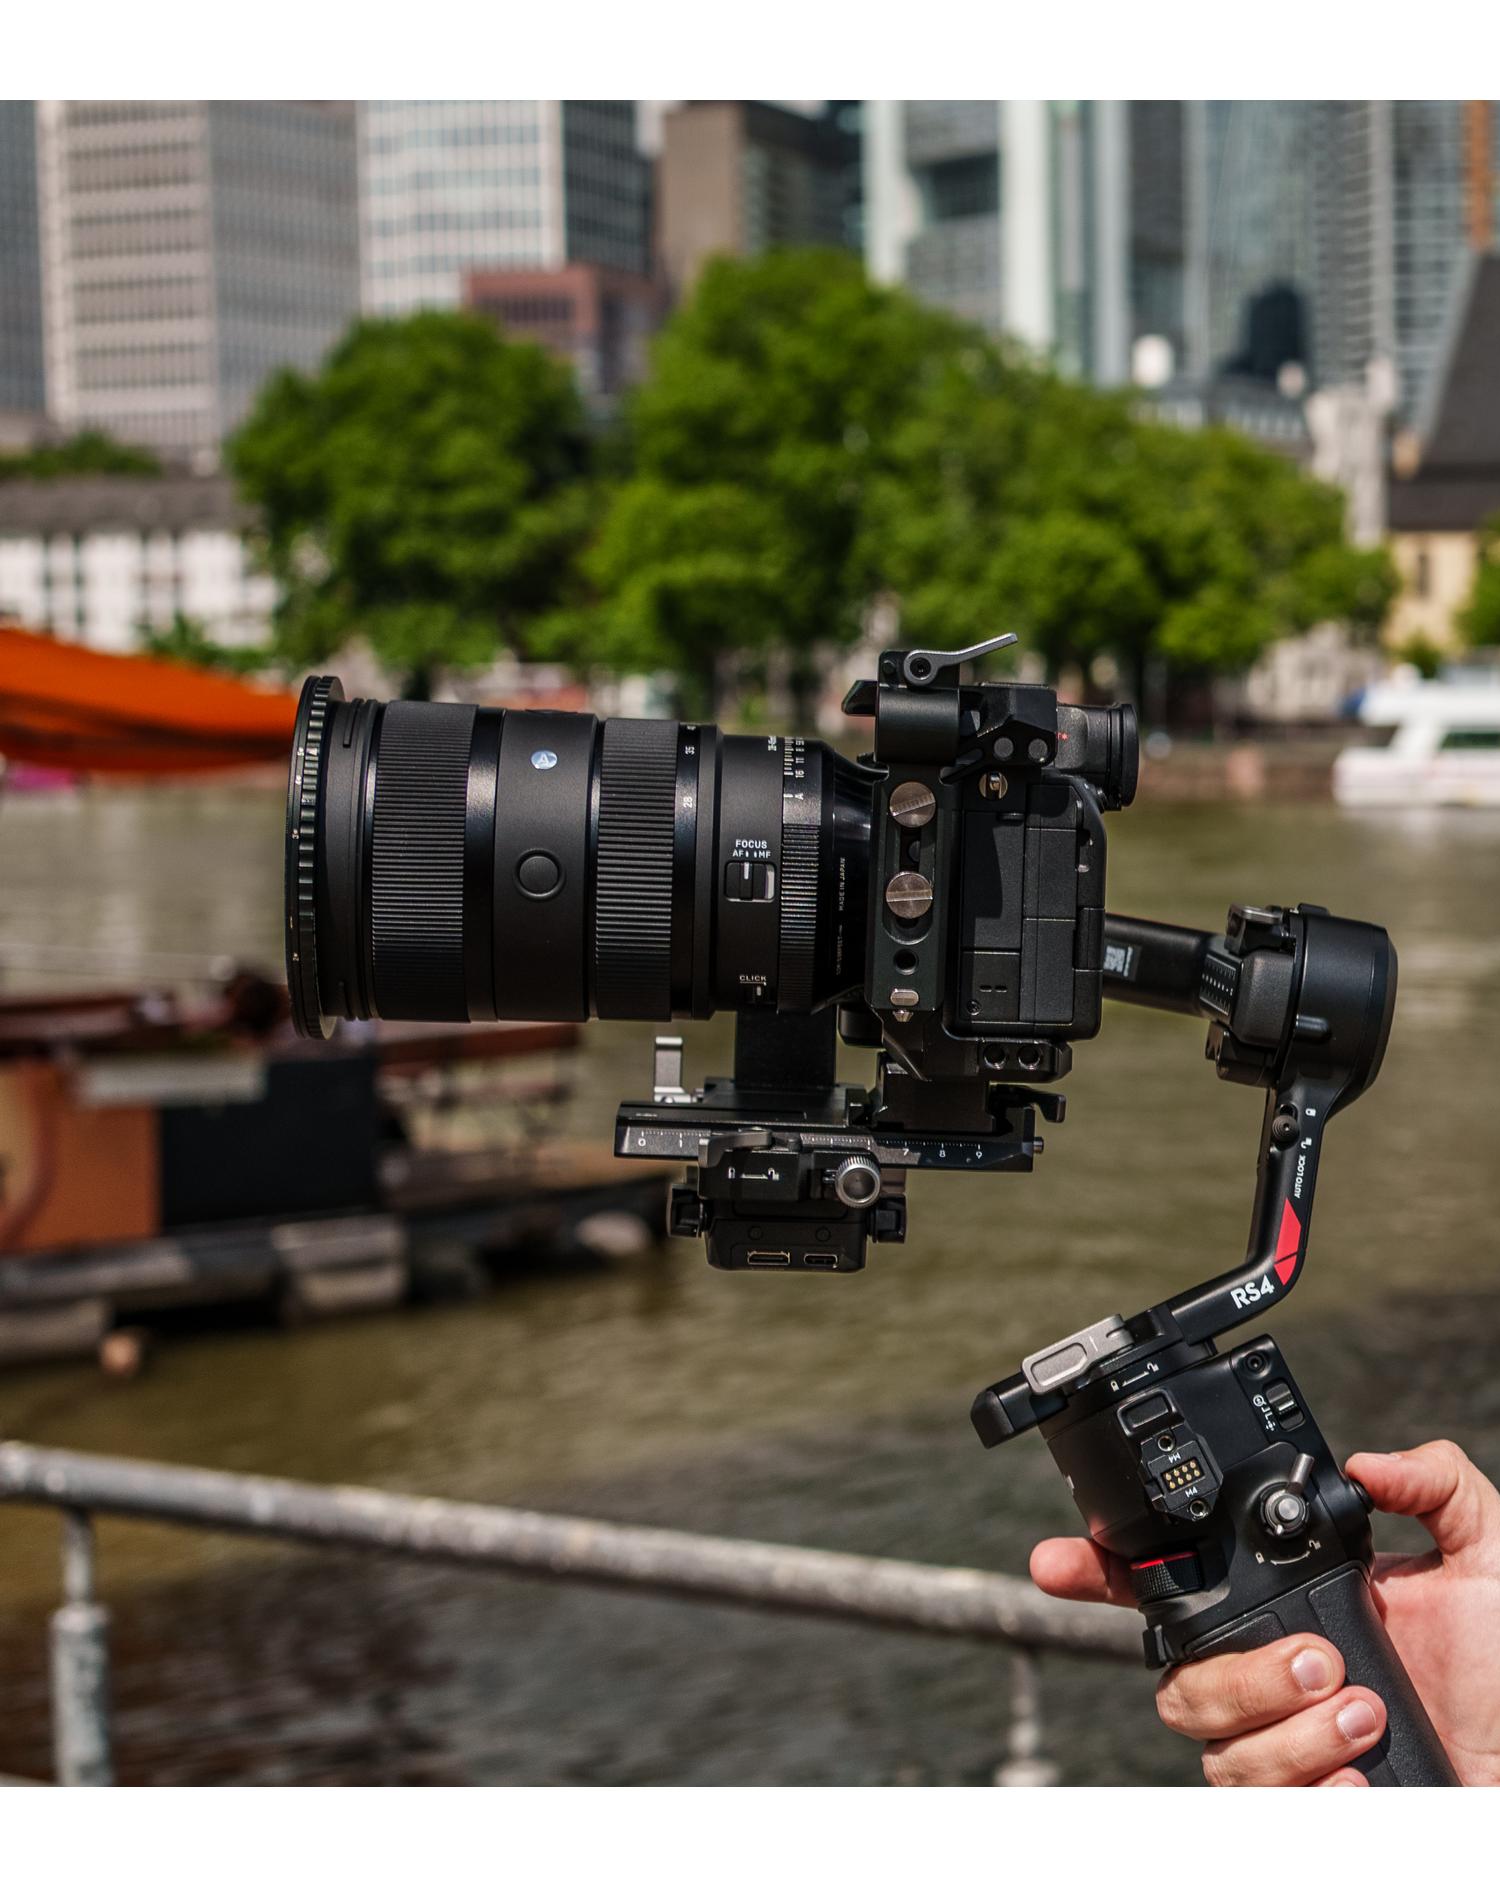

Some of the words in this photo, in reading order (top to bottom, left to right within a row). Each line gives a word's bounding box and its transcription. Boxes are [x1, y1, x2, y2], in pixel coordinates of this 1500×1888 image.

[795, 769, 804, 778] 16
[683, 796, 693, 808] 28
[735, 839, 767, 849] FOCUS
[732, 849, 744, 857] AF
[758, 850, 771, 859] MF
[902, 1148, 910, 1156] 7
[939, 1149, 946, 1158] 8
[975, 1151, 982, 1159] 9
[1296, 1154, 1306, 1177] LOCK
[1294, 1176, 1303, 1199] AUTO
[1230, 1274, 1275, 1309] RS4
[1185, 1486, 1198, 1498] M4
